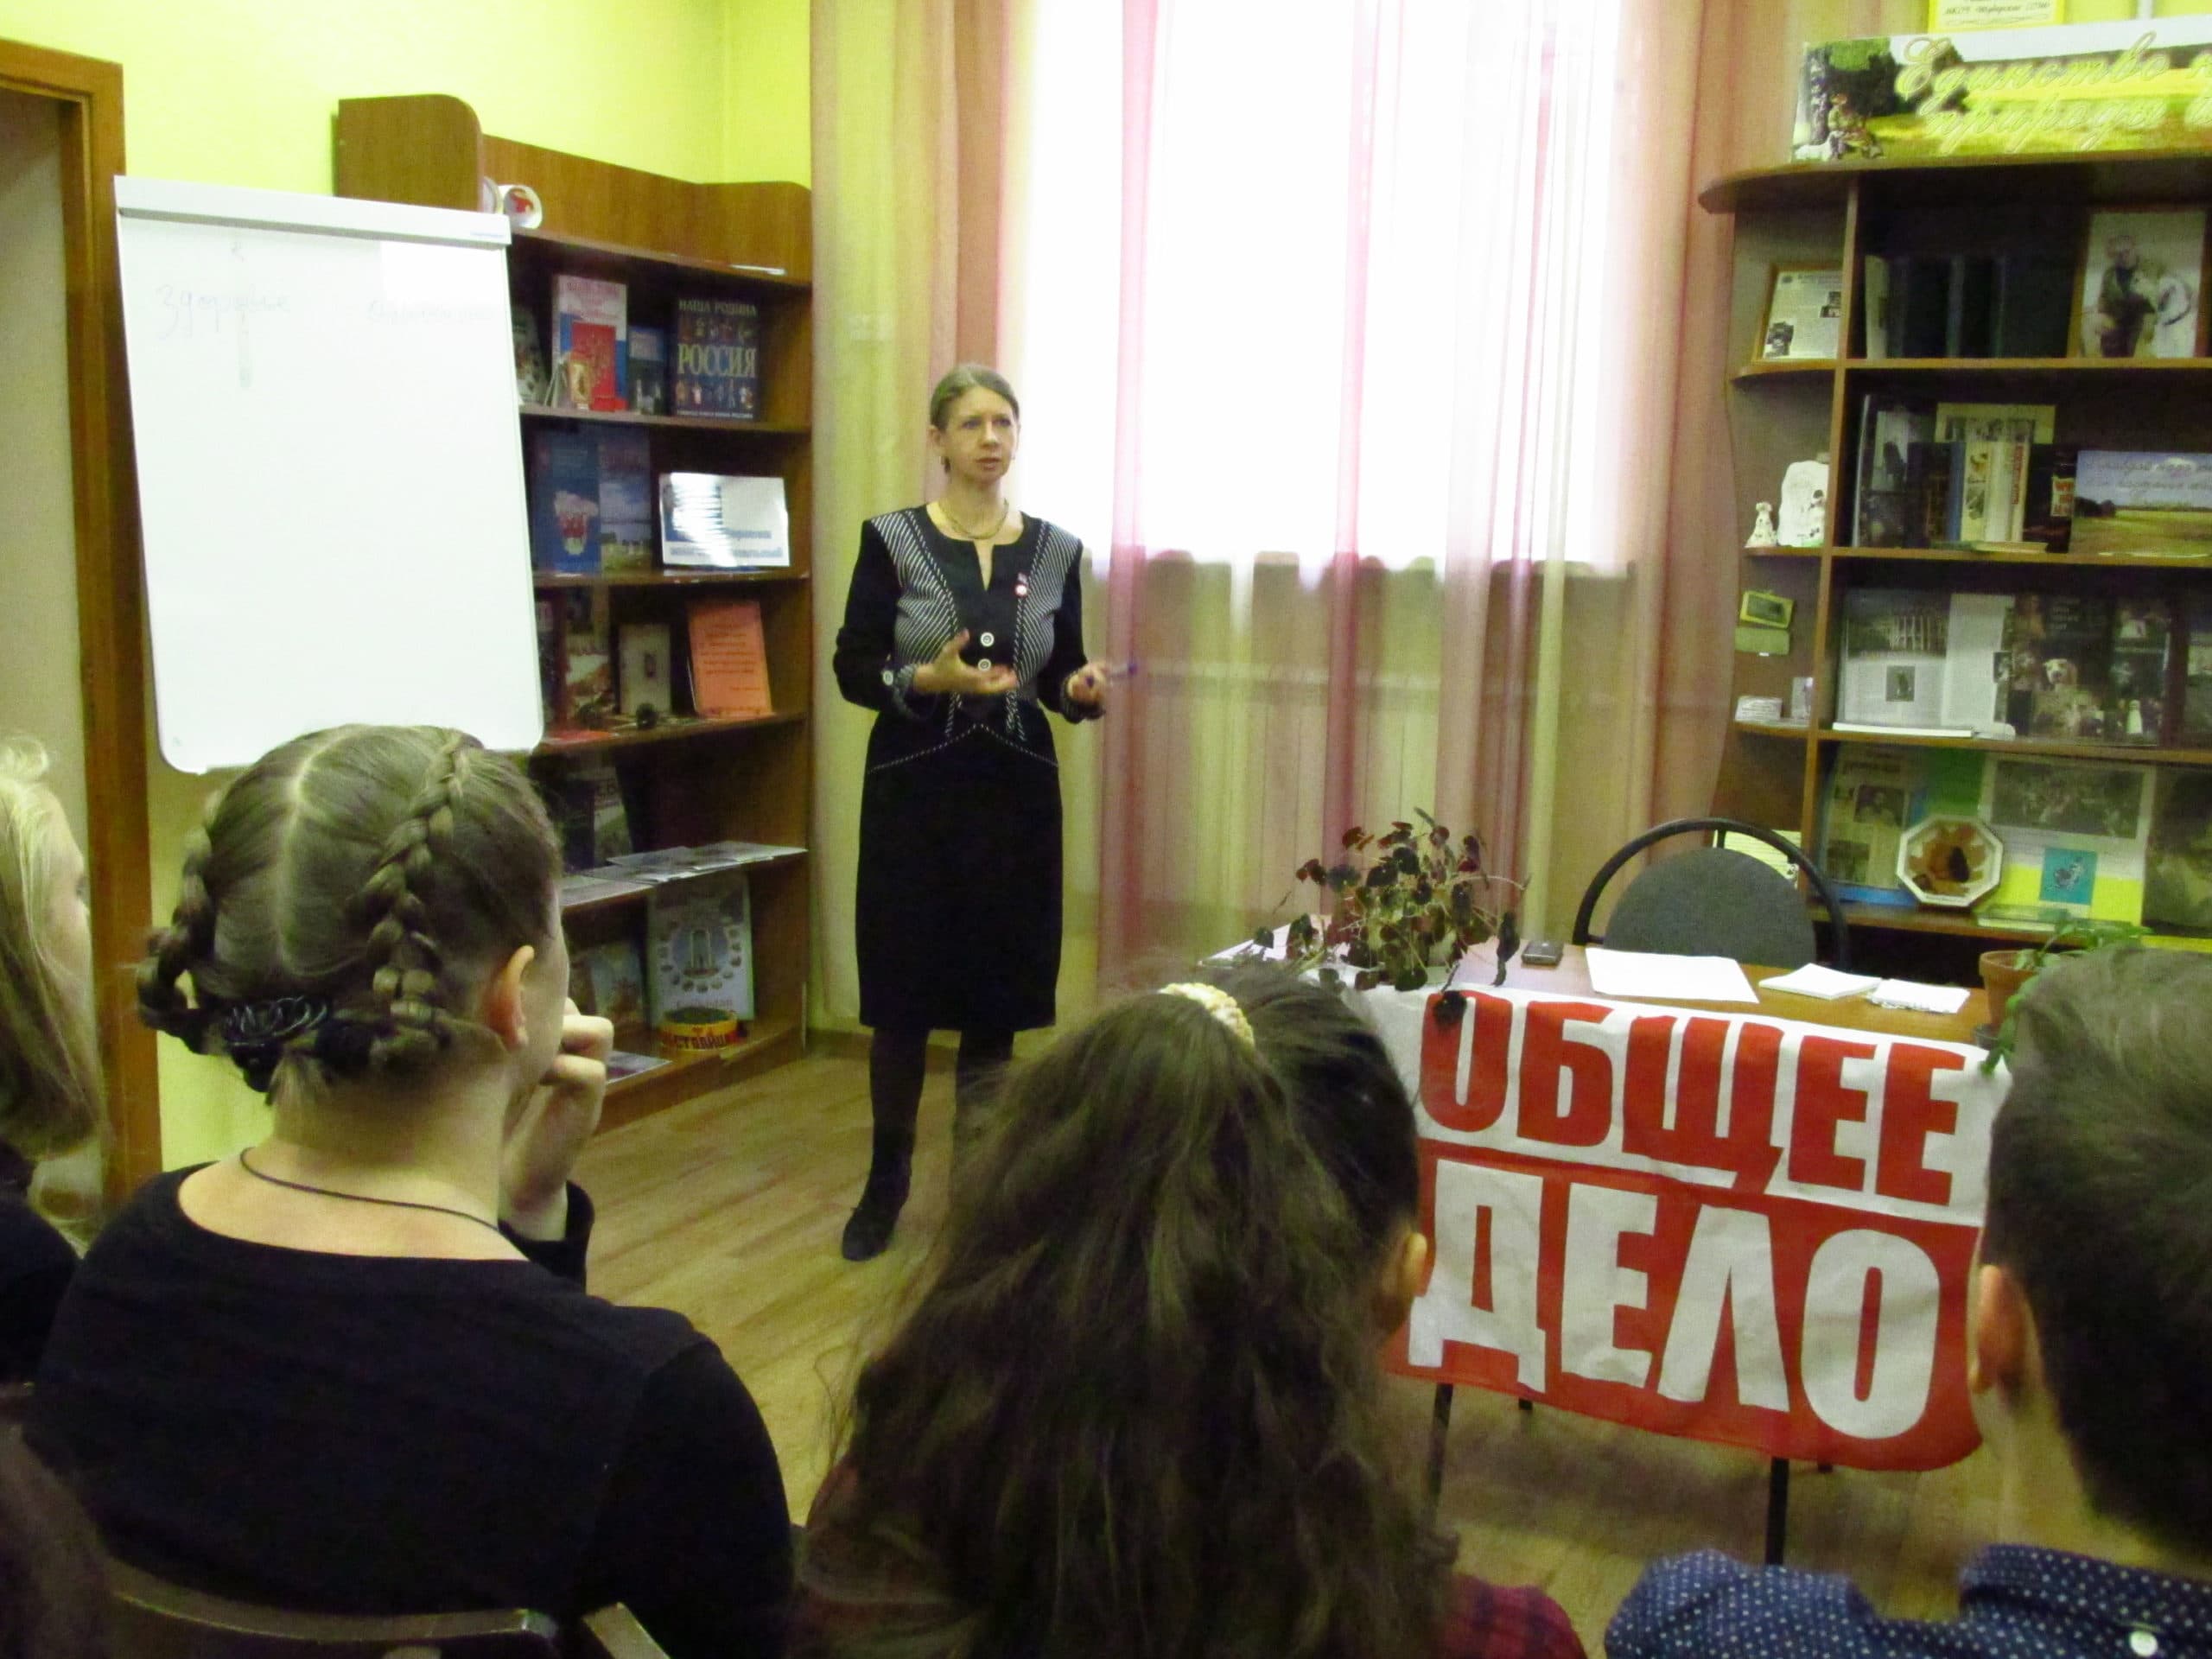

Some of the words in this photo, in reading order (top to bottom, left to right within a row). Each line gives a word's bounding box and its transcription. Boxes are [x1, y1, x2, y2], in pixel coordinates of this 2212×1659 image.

[677, 343, 757, 378] РОССИЯ
[1421, 991, 1965, 1206] ОБЩЕЕ
[1408, 1160, 1940, 1439] ДЕЛО
